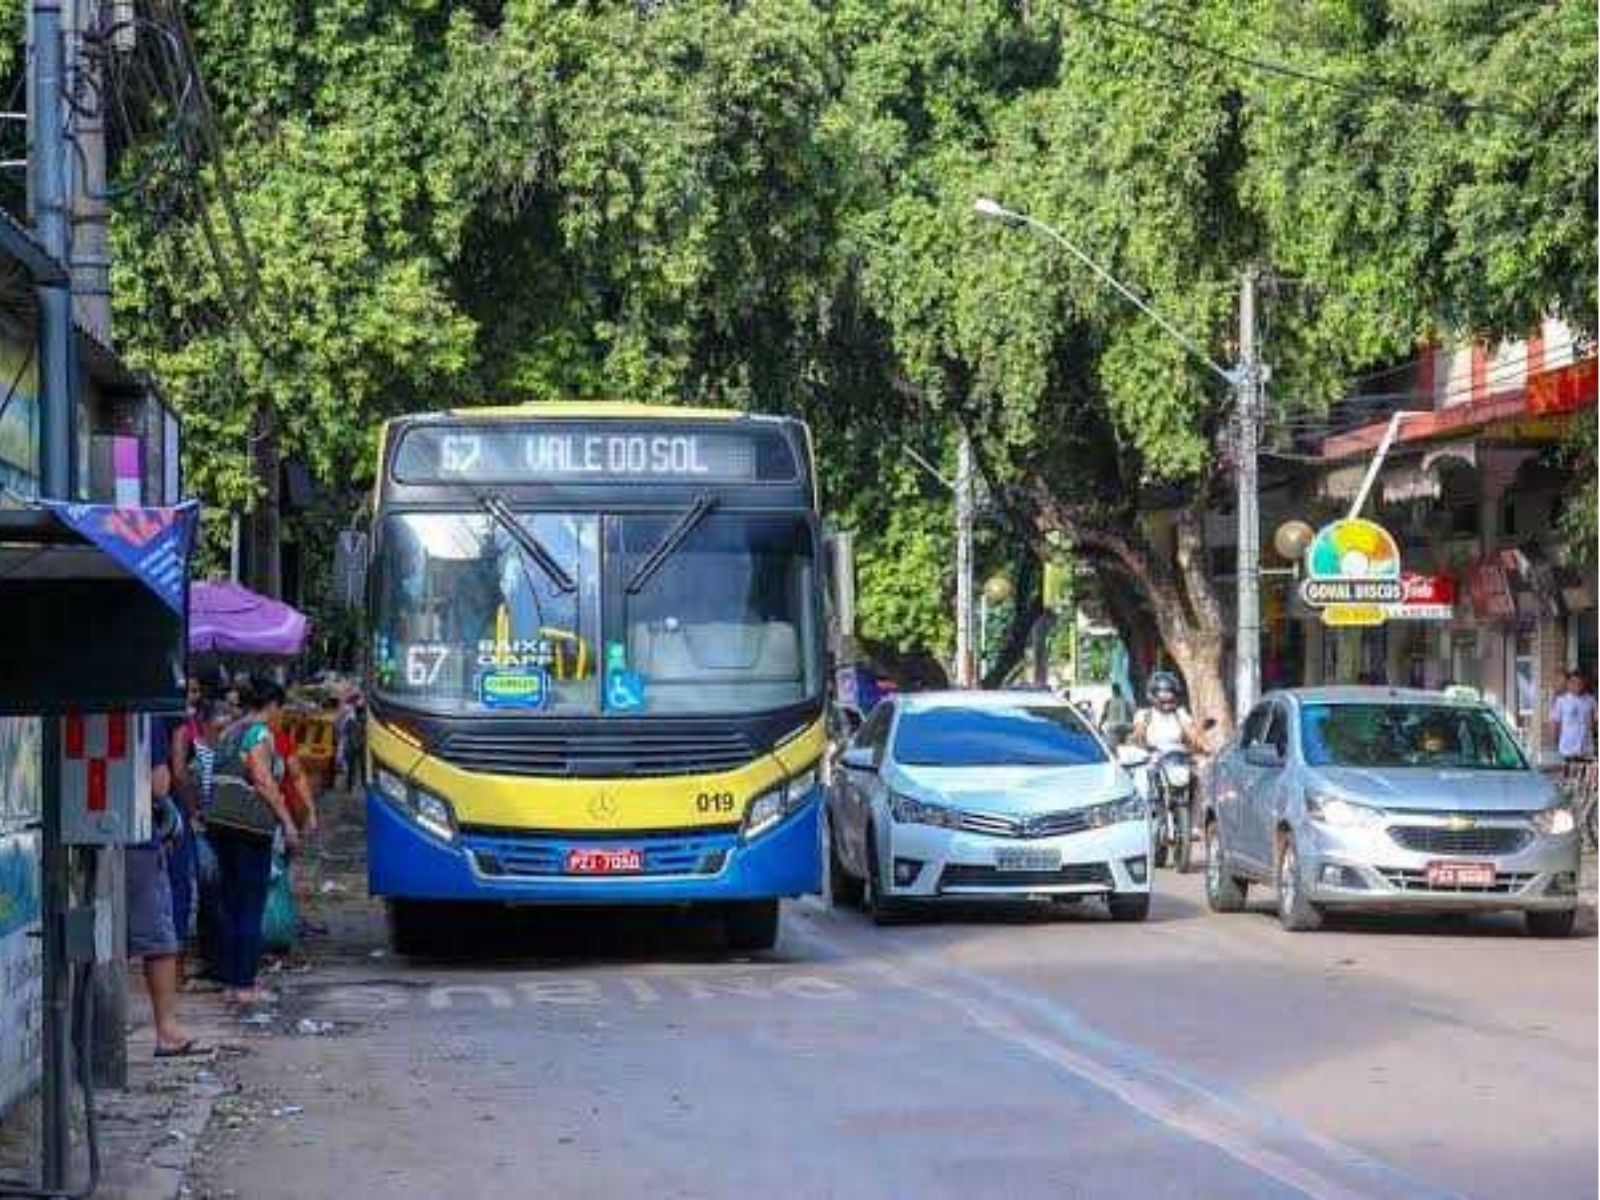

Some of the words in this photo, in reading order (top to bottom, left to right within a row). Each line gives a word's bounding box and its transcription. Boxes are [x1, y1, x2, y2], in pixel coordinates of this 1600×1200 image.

[441, 436, 481, 472] 67
[526, 436, 601, 471] VALE
[609, 437, 647, 473] DO
[652, 437, 708, 472] SOL
[407, 645, 448, 686] 67
[697, 793, 735, 812] 019
